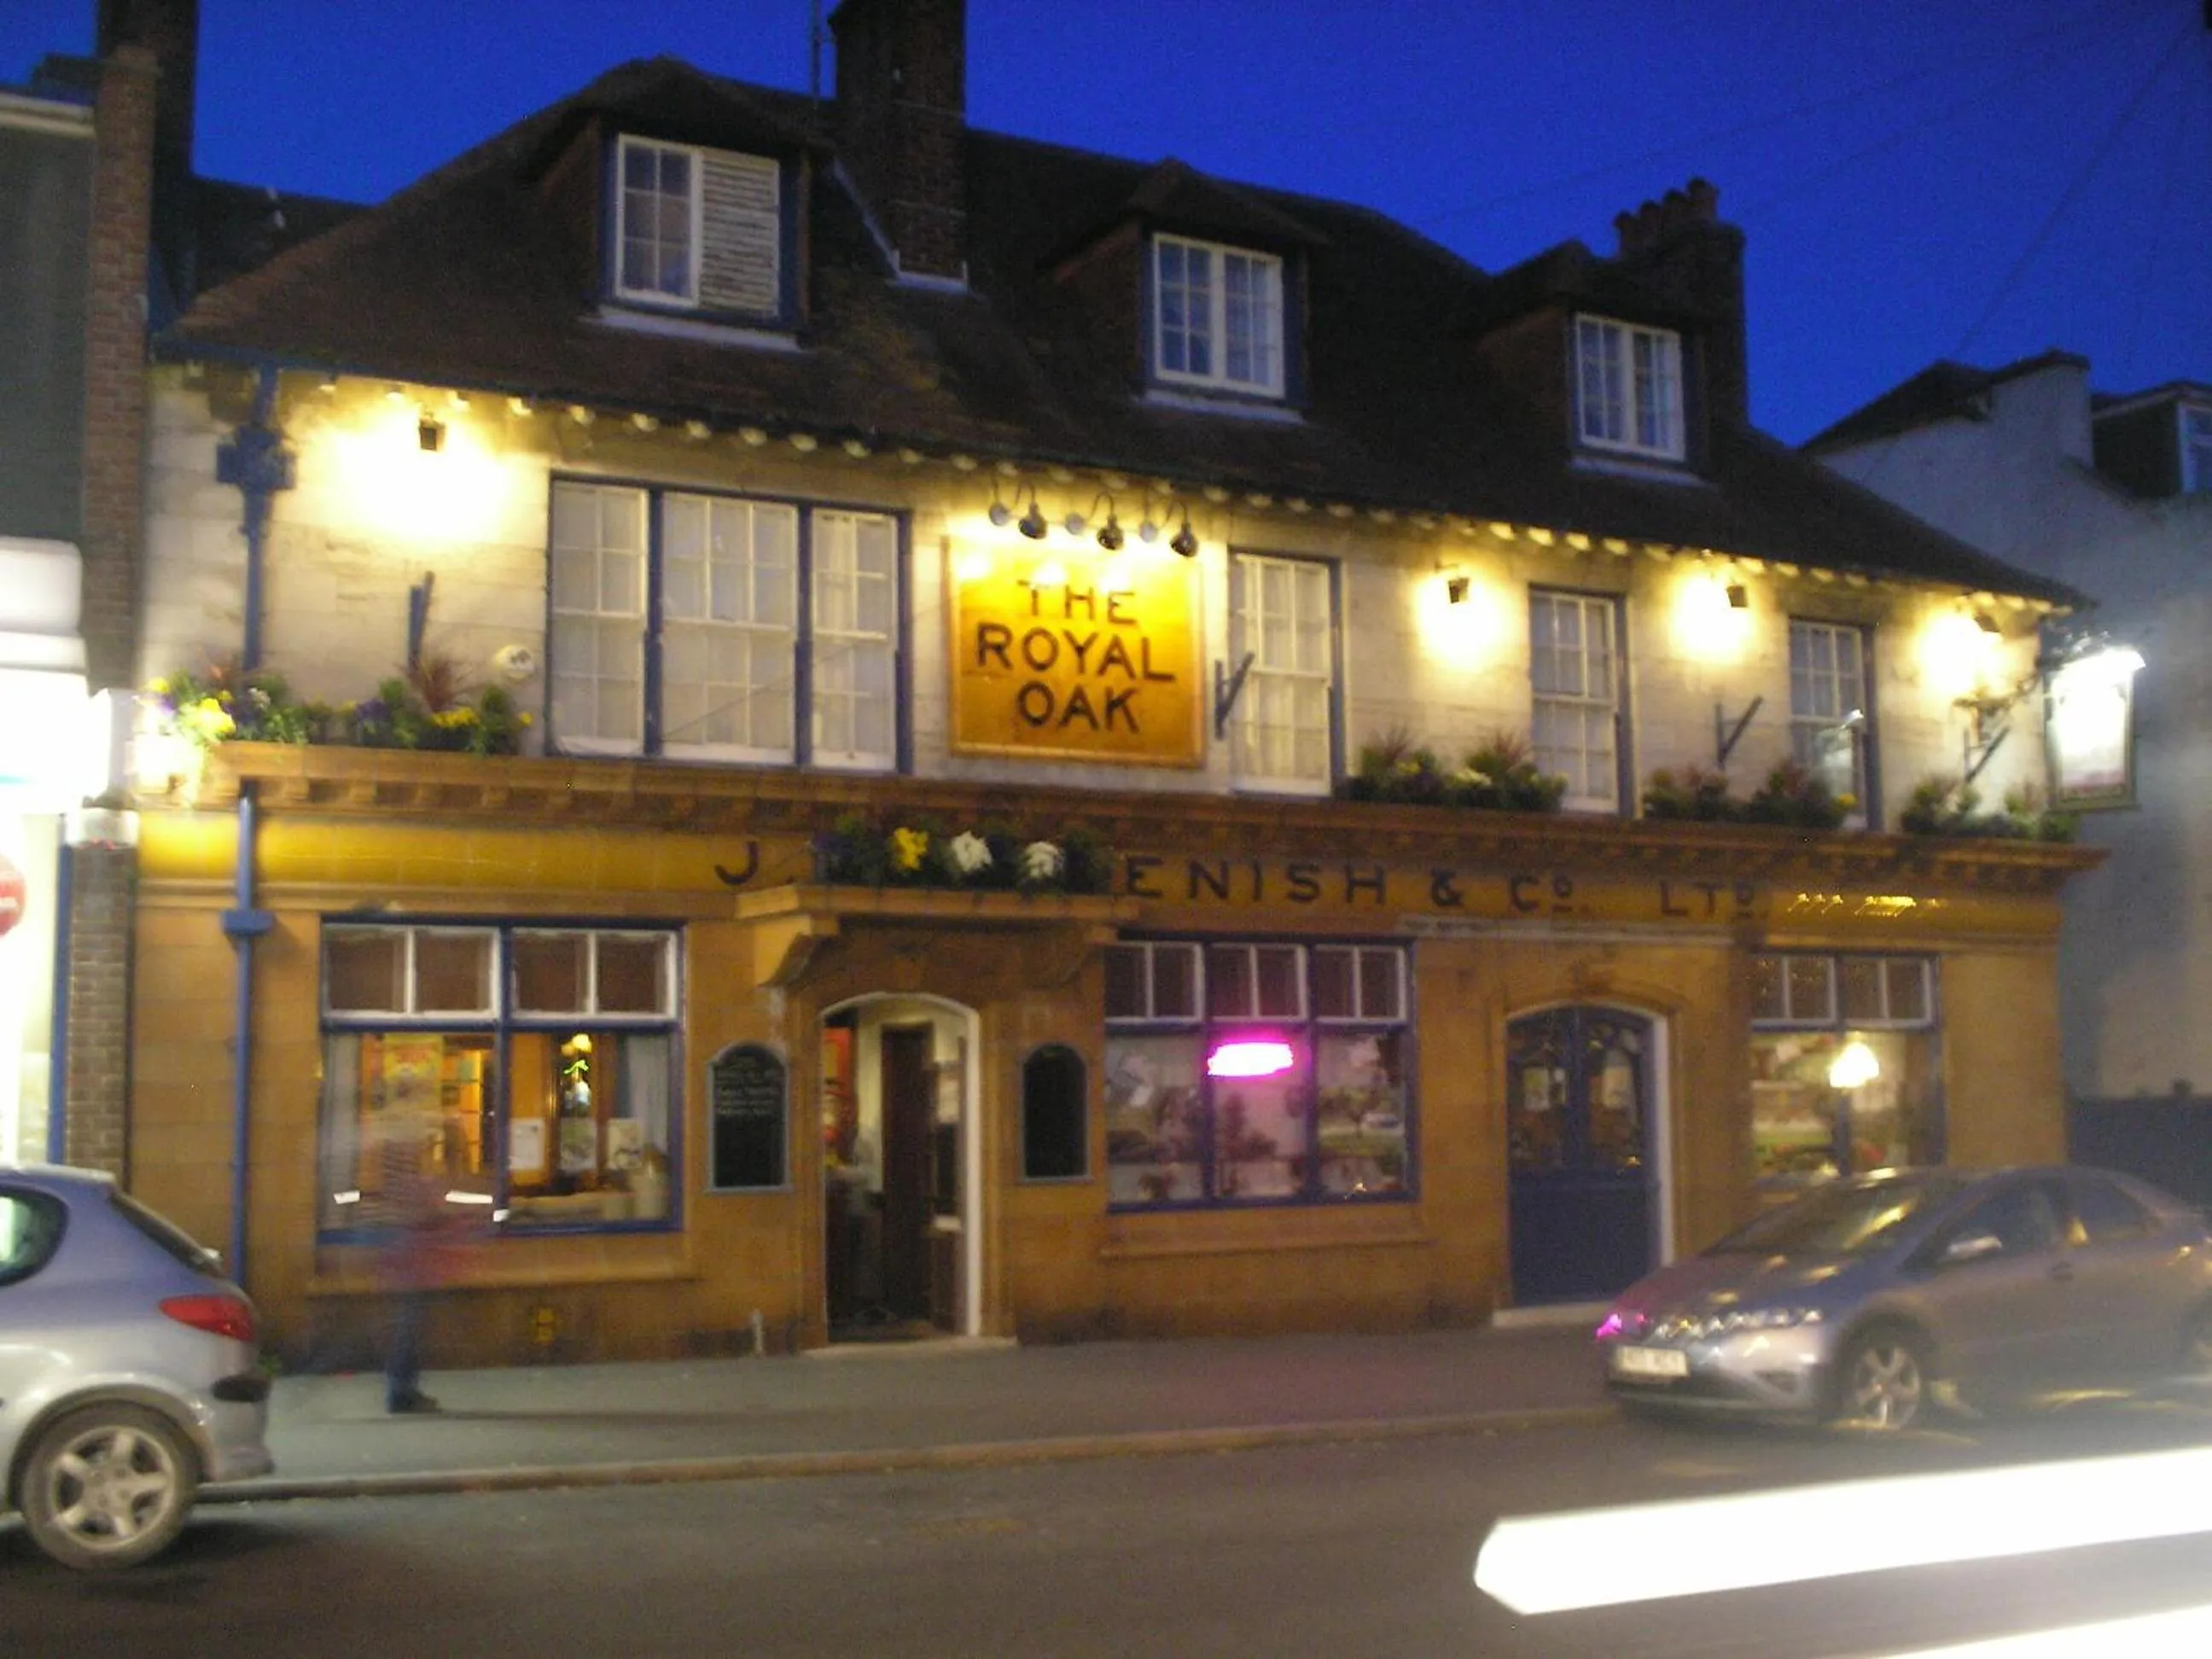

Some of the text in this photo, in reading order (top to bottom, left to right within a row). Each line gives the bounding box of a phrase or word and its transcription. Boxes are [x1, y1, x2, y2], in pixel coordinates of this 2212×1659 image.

[1017, 579, 1138, 625] THE
[977, 622, 1177, 682] ROYAL
[1017, 680, 1139, 733] OAK
[1124, 856, 1387, 905] ENISH
[1429, 866, 1464, 907] &
